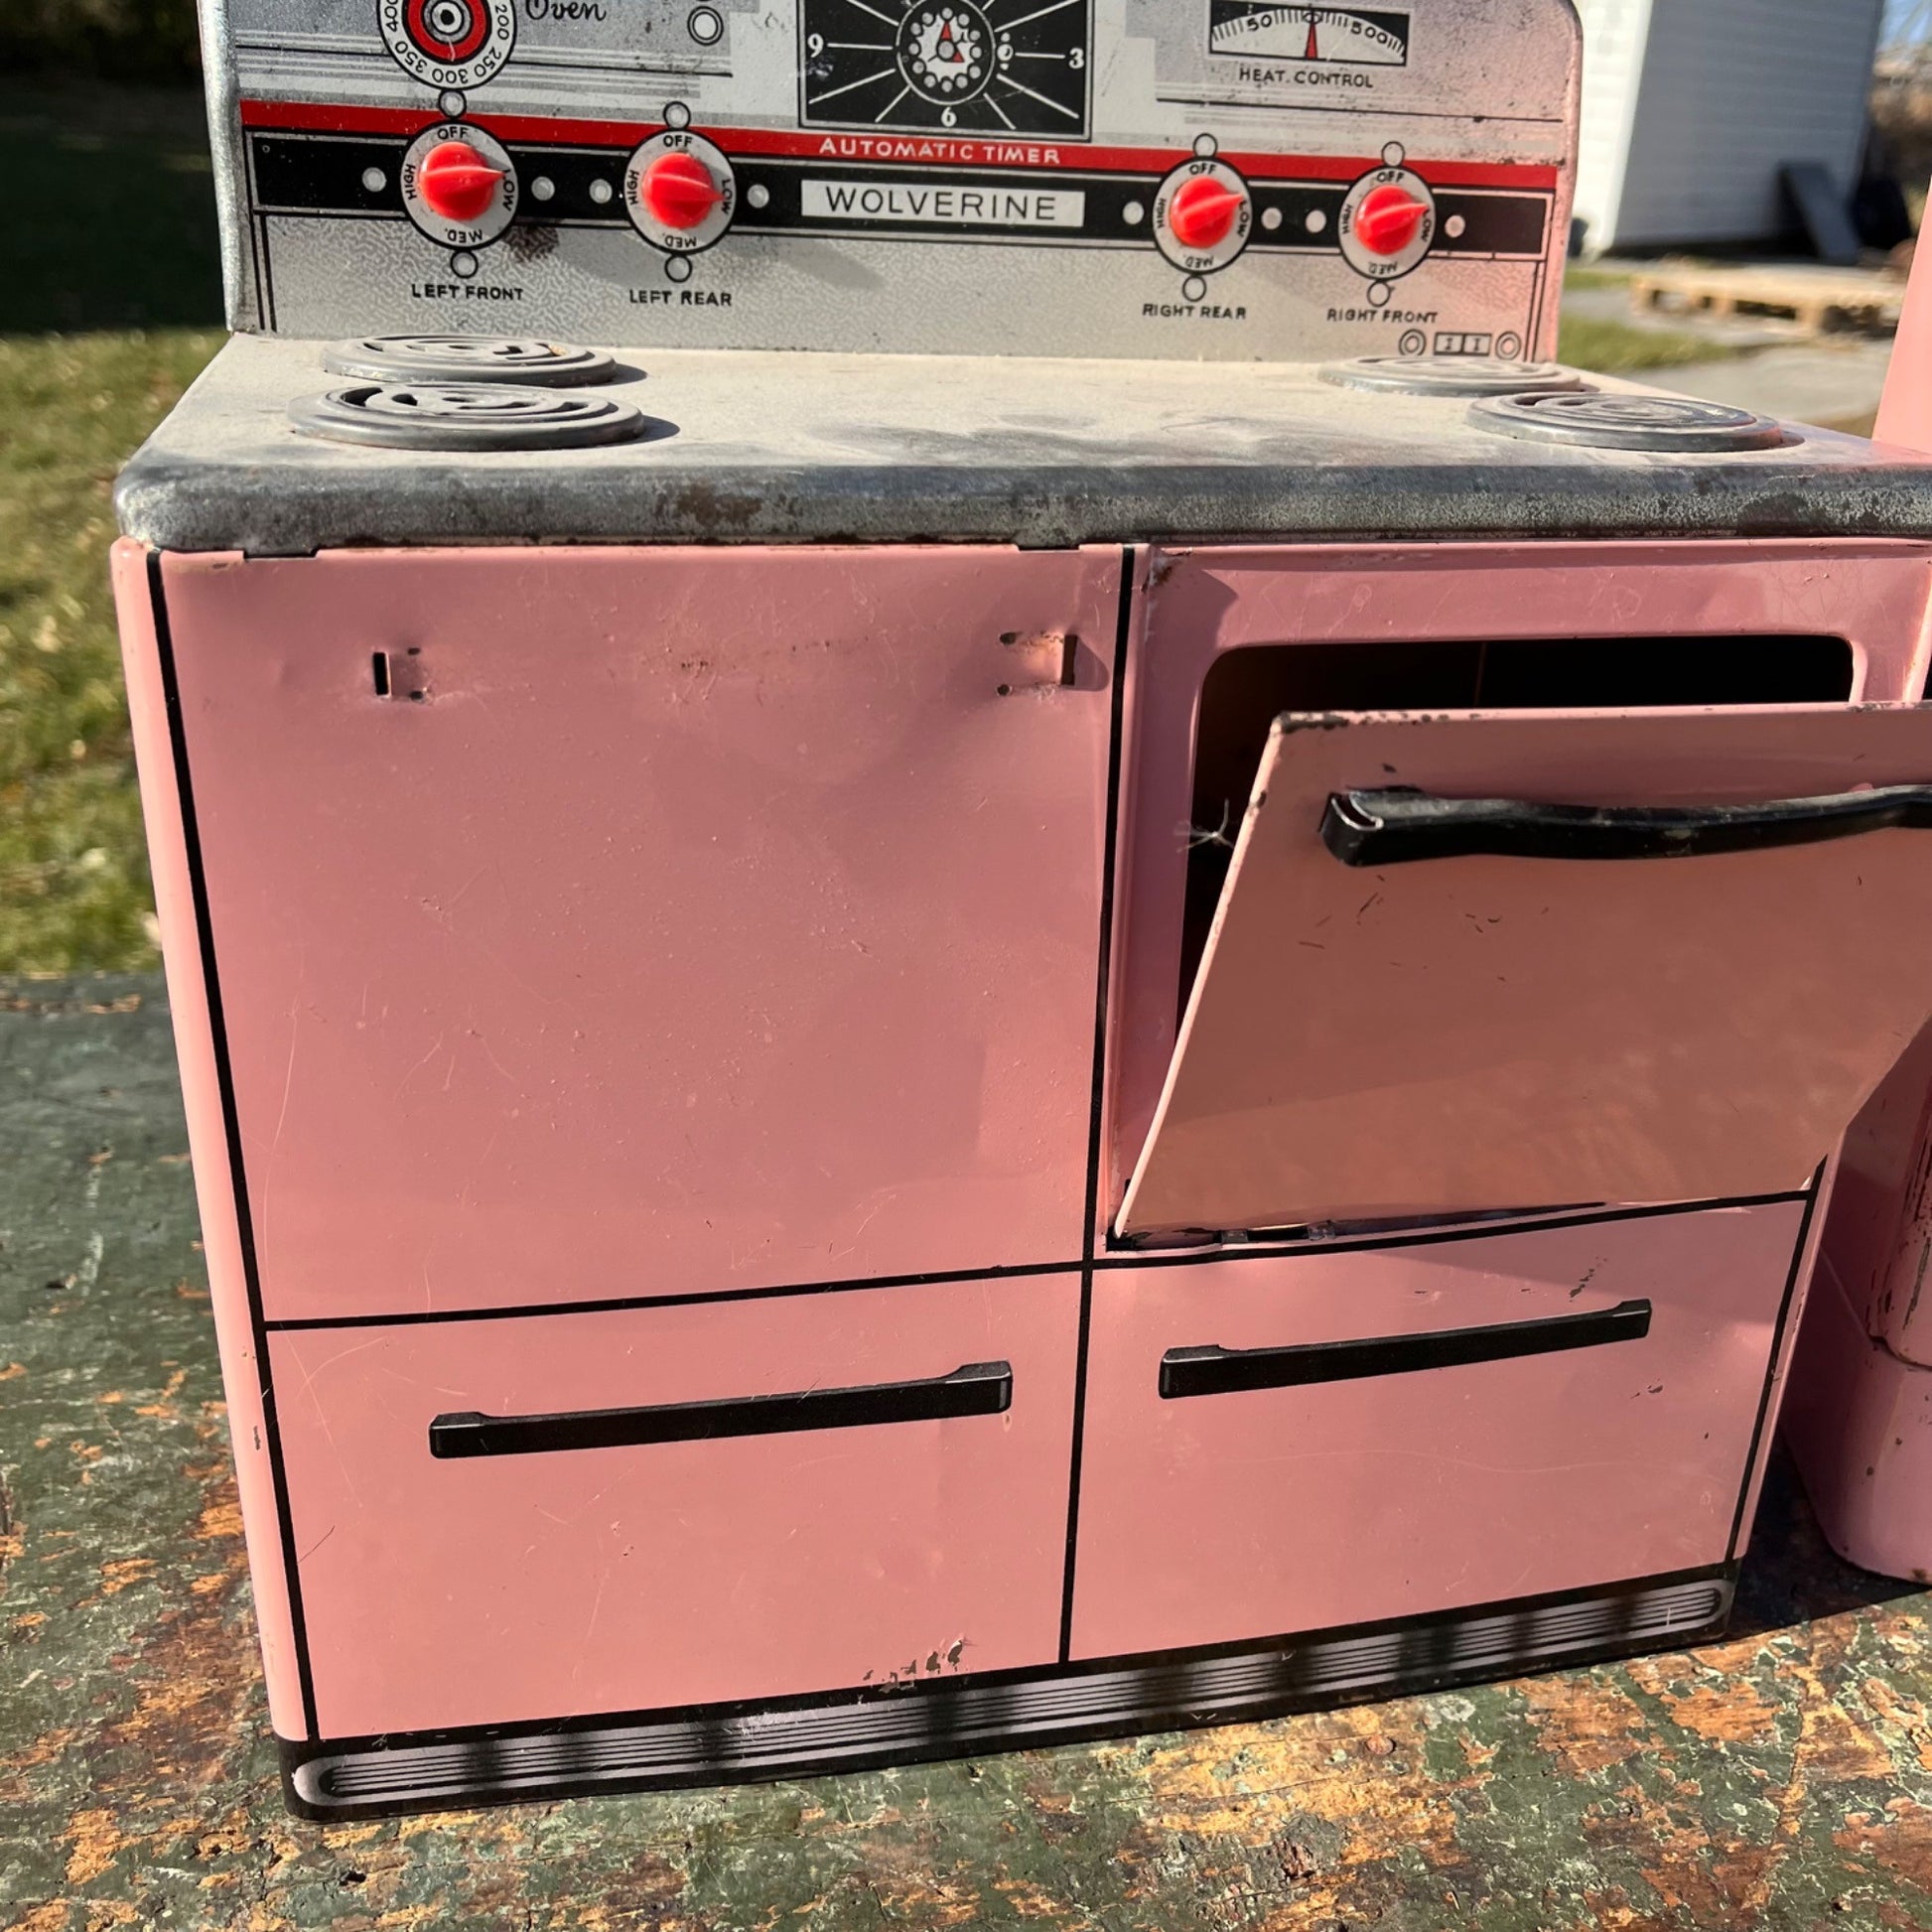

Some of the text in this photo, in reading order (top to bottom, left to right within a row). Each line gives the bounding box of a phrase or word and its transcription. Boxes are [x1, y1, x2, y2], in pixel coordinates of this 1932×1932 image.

[494, 5, 510, 41] 200
[1247, 14, 1273, 32] 50
[1350, 21, 1388, 45] 500
[807, 33, 824, 58] 9
[394, 41, 427, 73] 350
[474, 47, 501, 77] 250
[1068, 48, 1085, 69] 3
[432, 68, 469, 83] 300
[1239, 69, 1373, 88] HEAT CONTROL
[940, 106, 957, 127] 6
[437, 126, 469, 140] OFF
[663, 135, 693, 148] OFF
[819, 138, 1060, 165] AUTOMATIC TIMER
[1188, 163, 1217, 176] OFF
[1376, 171, 1405, 183] OFF
[404, 164, 417, 201] HIGH
[502, 168, 515, 211] LOW
[627, 170, 639, 206] HIGH
[722, 178, 733, 214] LOW
[826, 186, 1056, 220] WOLVERINE
[1156, 198, 1167, 228] HIGH
[1237, 200, 1251, 237] LOW
[1341, 204, 1353, 234] HIGH
[445, 228, 483, 243] MED.
[1421, 207, 1433, 242] LOW
[662, 233, 697, 248] MED.
[411, 284, 523, 301] LEFT FRONT
[629, 290, 732, 306] LEFT REAR
[1143, 304, 1247, 319] RIGHT REAR
[1327, 309, 1438, 324] RIGHT FRONT
